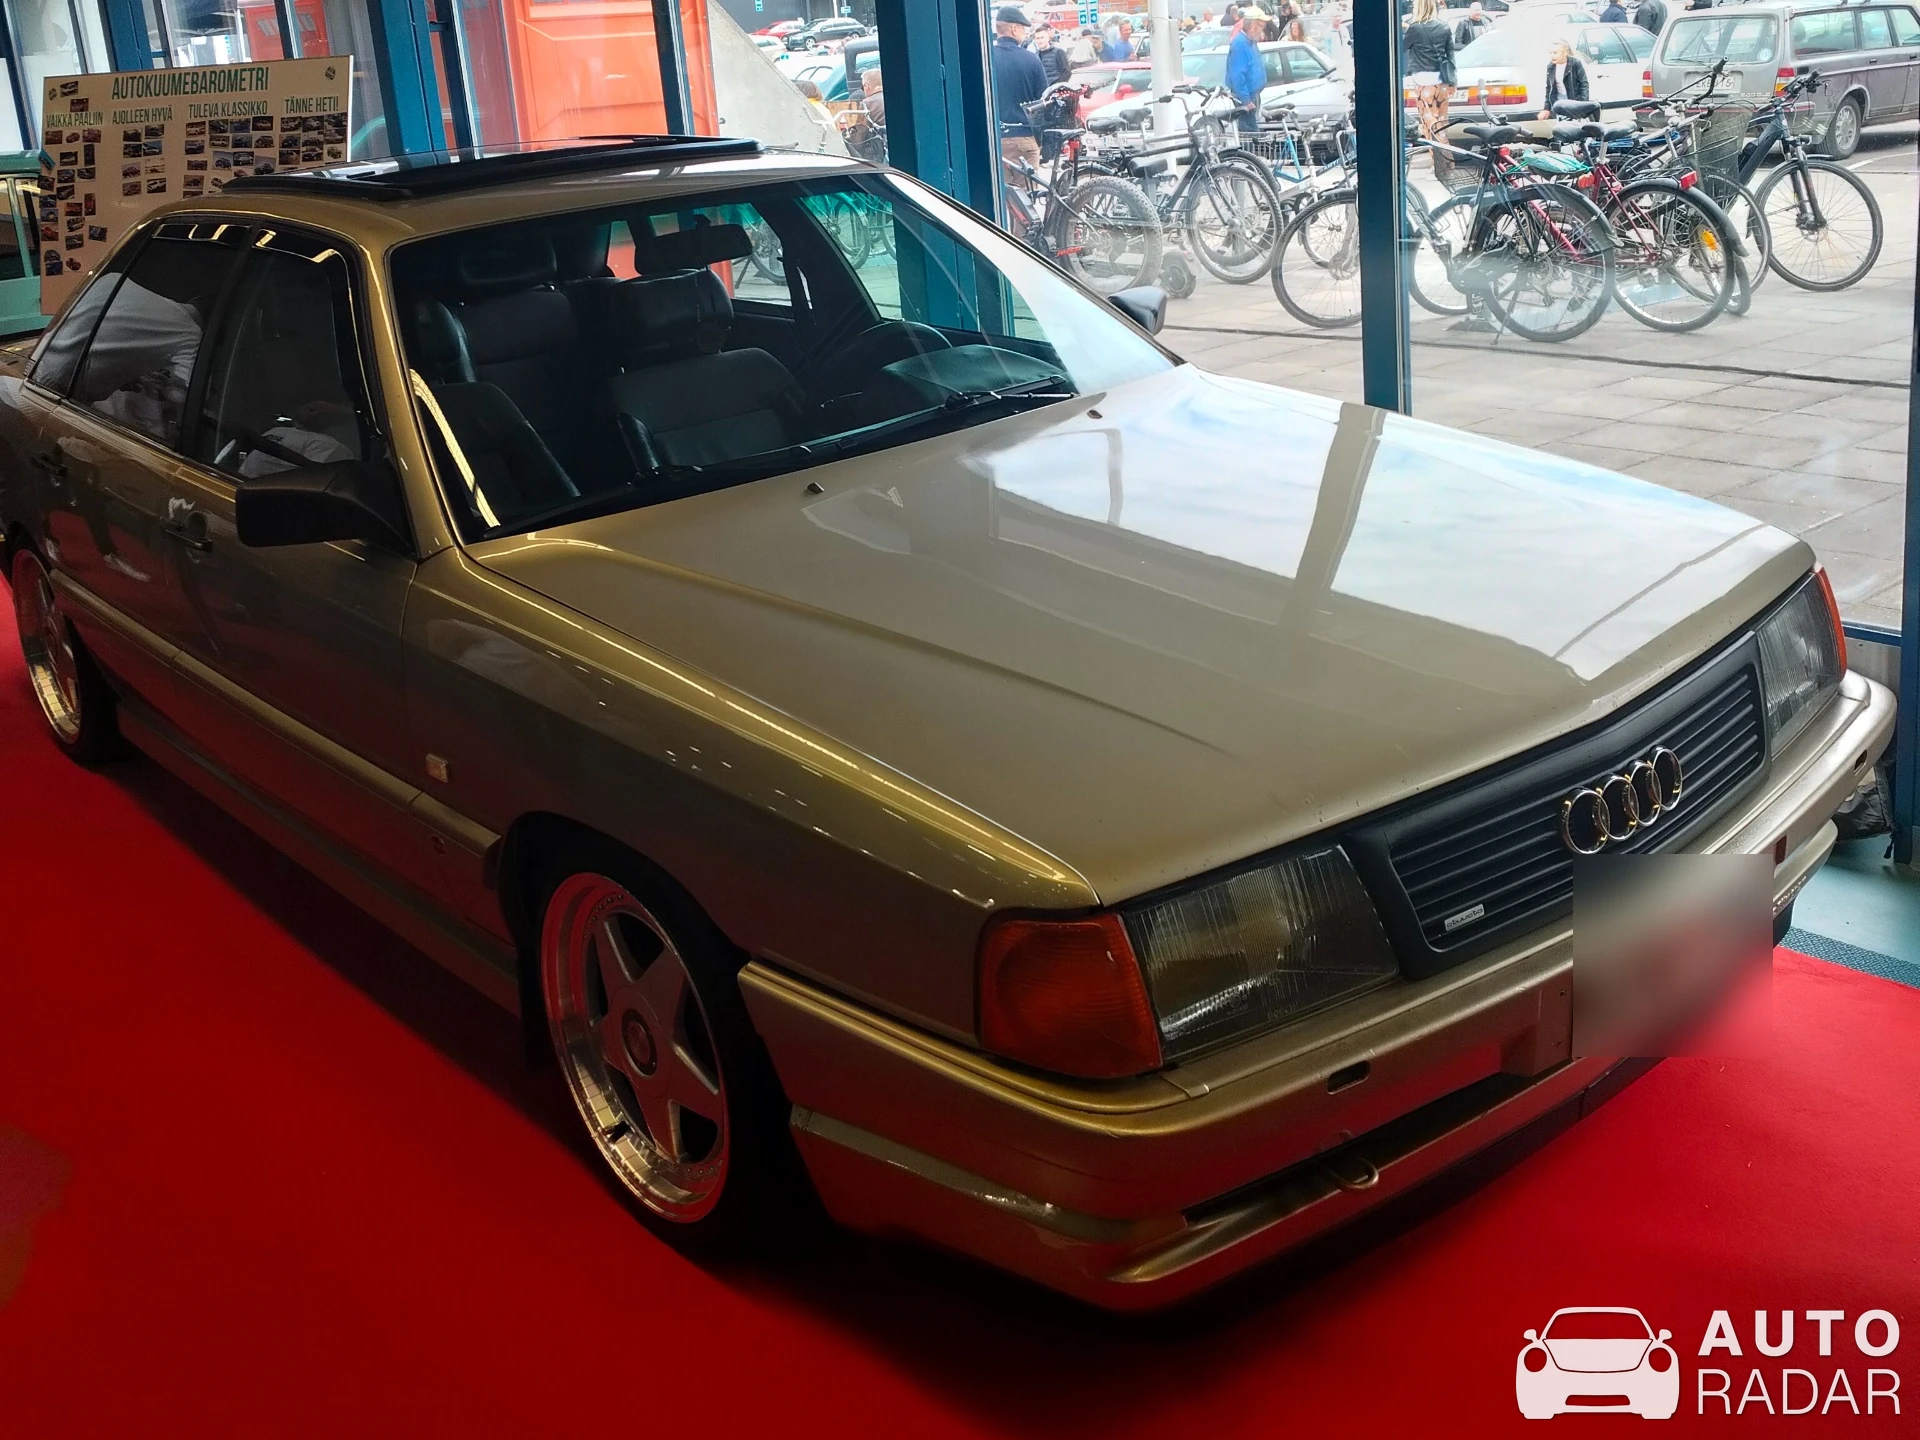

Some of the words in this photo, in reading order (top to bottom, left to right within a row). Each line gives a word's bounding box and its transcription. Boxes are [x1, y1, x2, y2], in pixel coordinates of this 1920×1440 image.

[112, 67, 269, 100] AUTOKUUMEBAROMETRI
[188, 102, 219, 118] TULEVA
[221, 100, 268, 117] KLASSIKKO
[285, 97, 313, 113] TÄNNE
[315, 95, 339, 112] HETI!
[46, 113, 72, 128] VAIKKA
[112, 109, 149, 124] AJOLLEEN
[151, 105, 173, 122] HYVÄ
